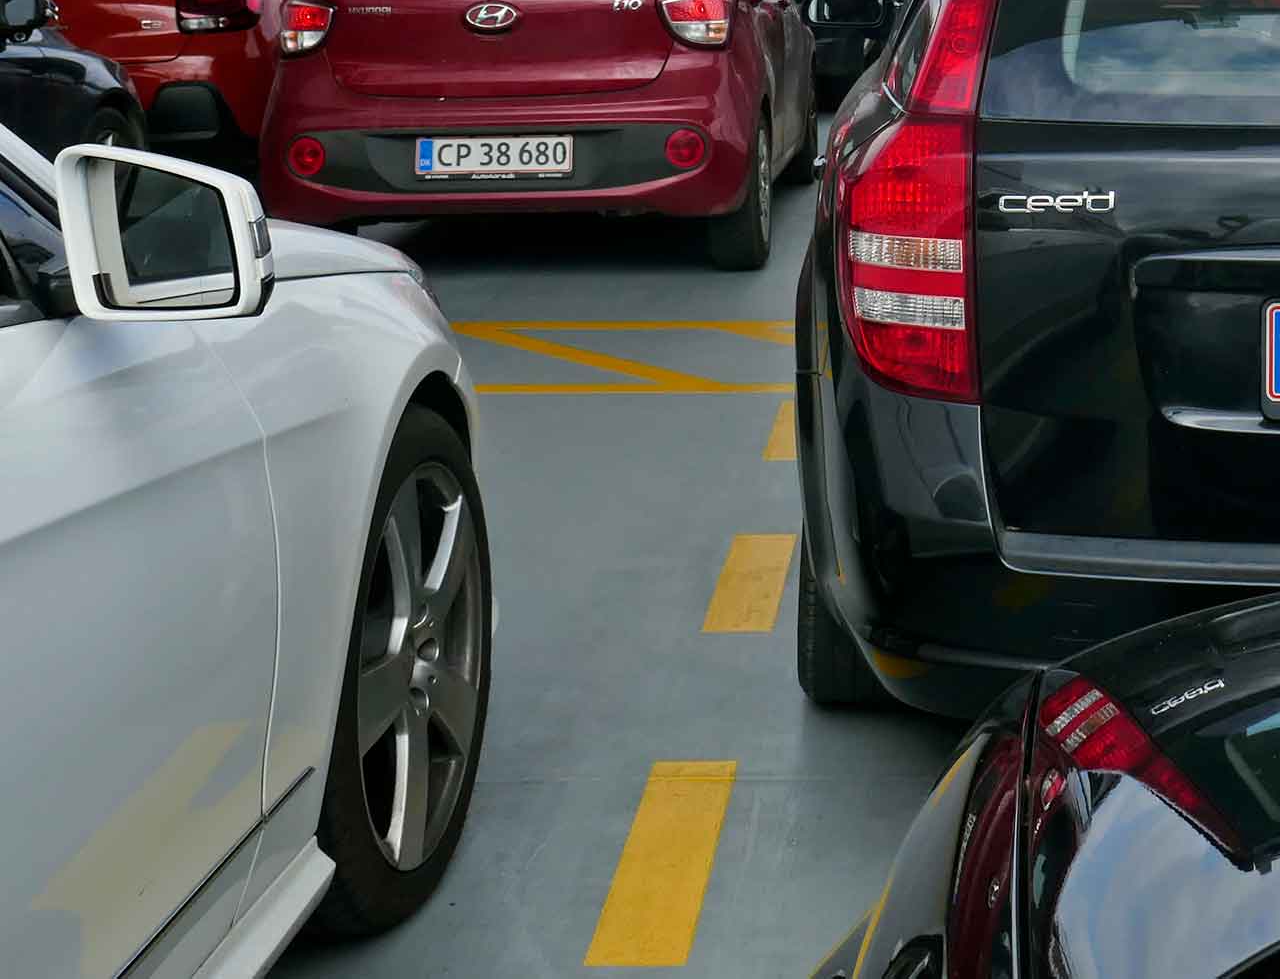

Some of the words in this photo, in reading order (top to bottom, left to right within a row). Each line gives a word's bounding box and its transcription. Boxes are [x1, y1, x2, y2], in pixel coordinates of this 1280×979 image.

[438, 143, 472, 167] CP
[479, 141, 511, 167] 38
[518, 140, 567, 166] 680
